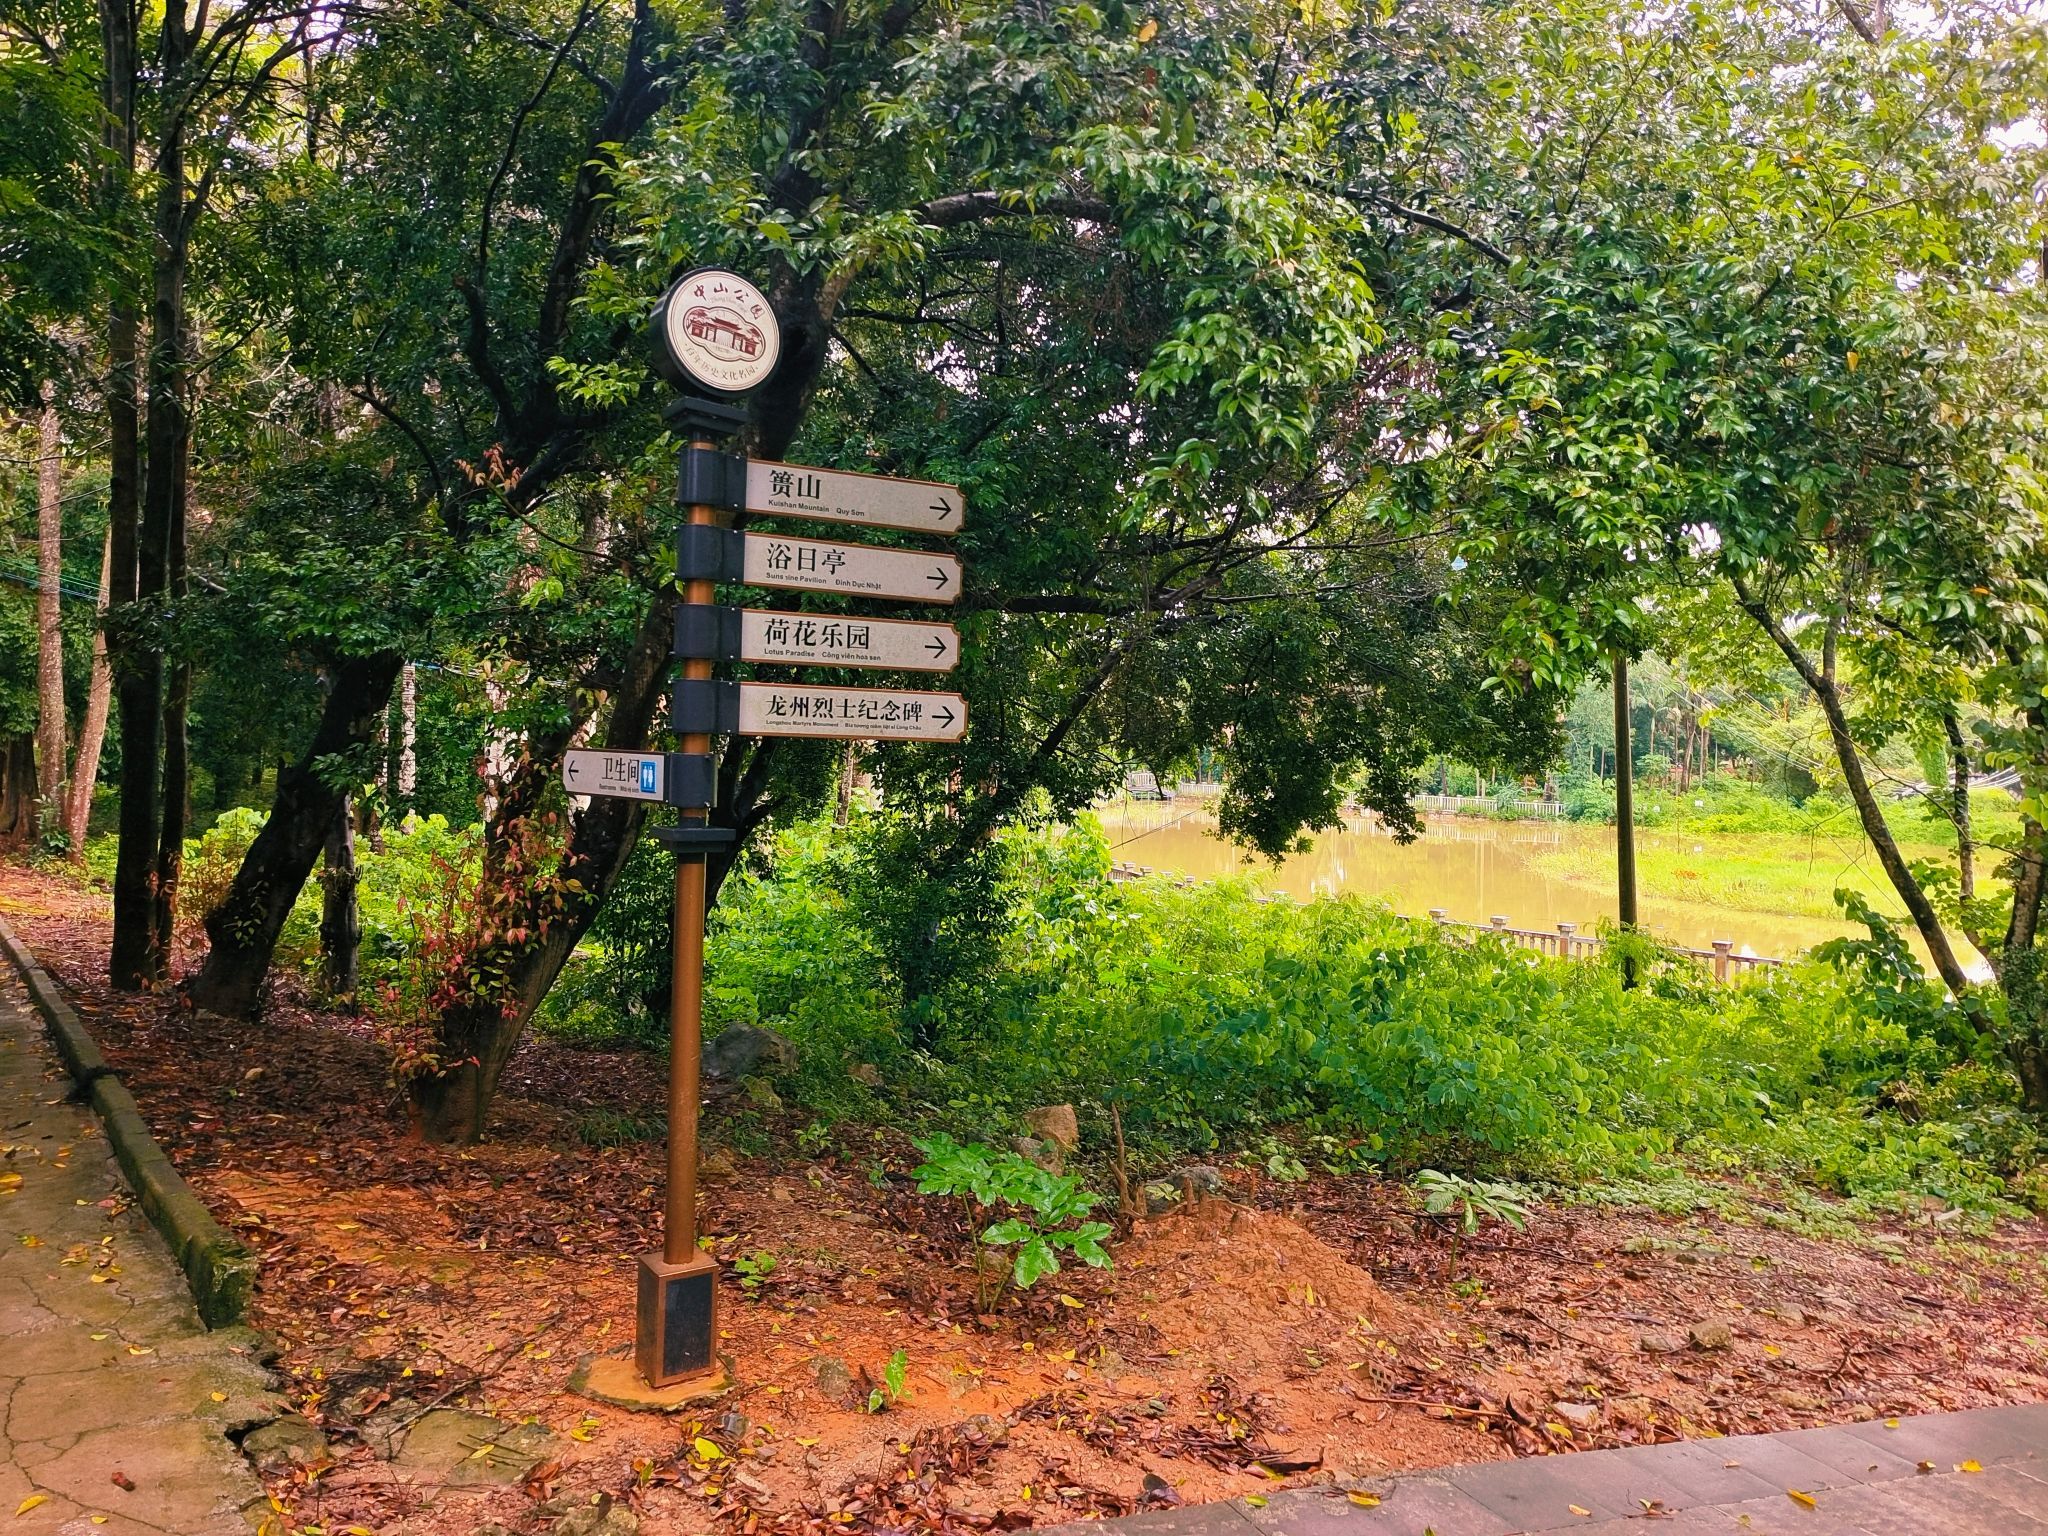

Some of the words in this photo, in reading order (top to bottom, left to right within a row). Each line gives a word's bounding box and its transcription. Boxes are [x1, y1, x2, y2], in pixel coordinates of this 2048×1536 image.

[798, 503, 830, 512] Mountain
[767, 543, 846, 575] 浴日亭
[799, 575, 827, 583] Pavilion
[765, 619, 869, 650] 荷花乐园
[785, 649, 815, 657] Paradise
[766, 695, 922, 722] 龙州烈士纪念碑
[602, 757, 639, 783] 卫生间
